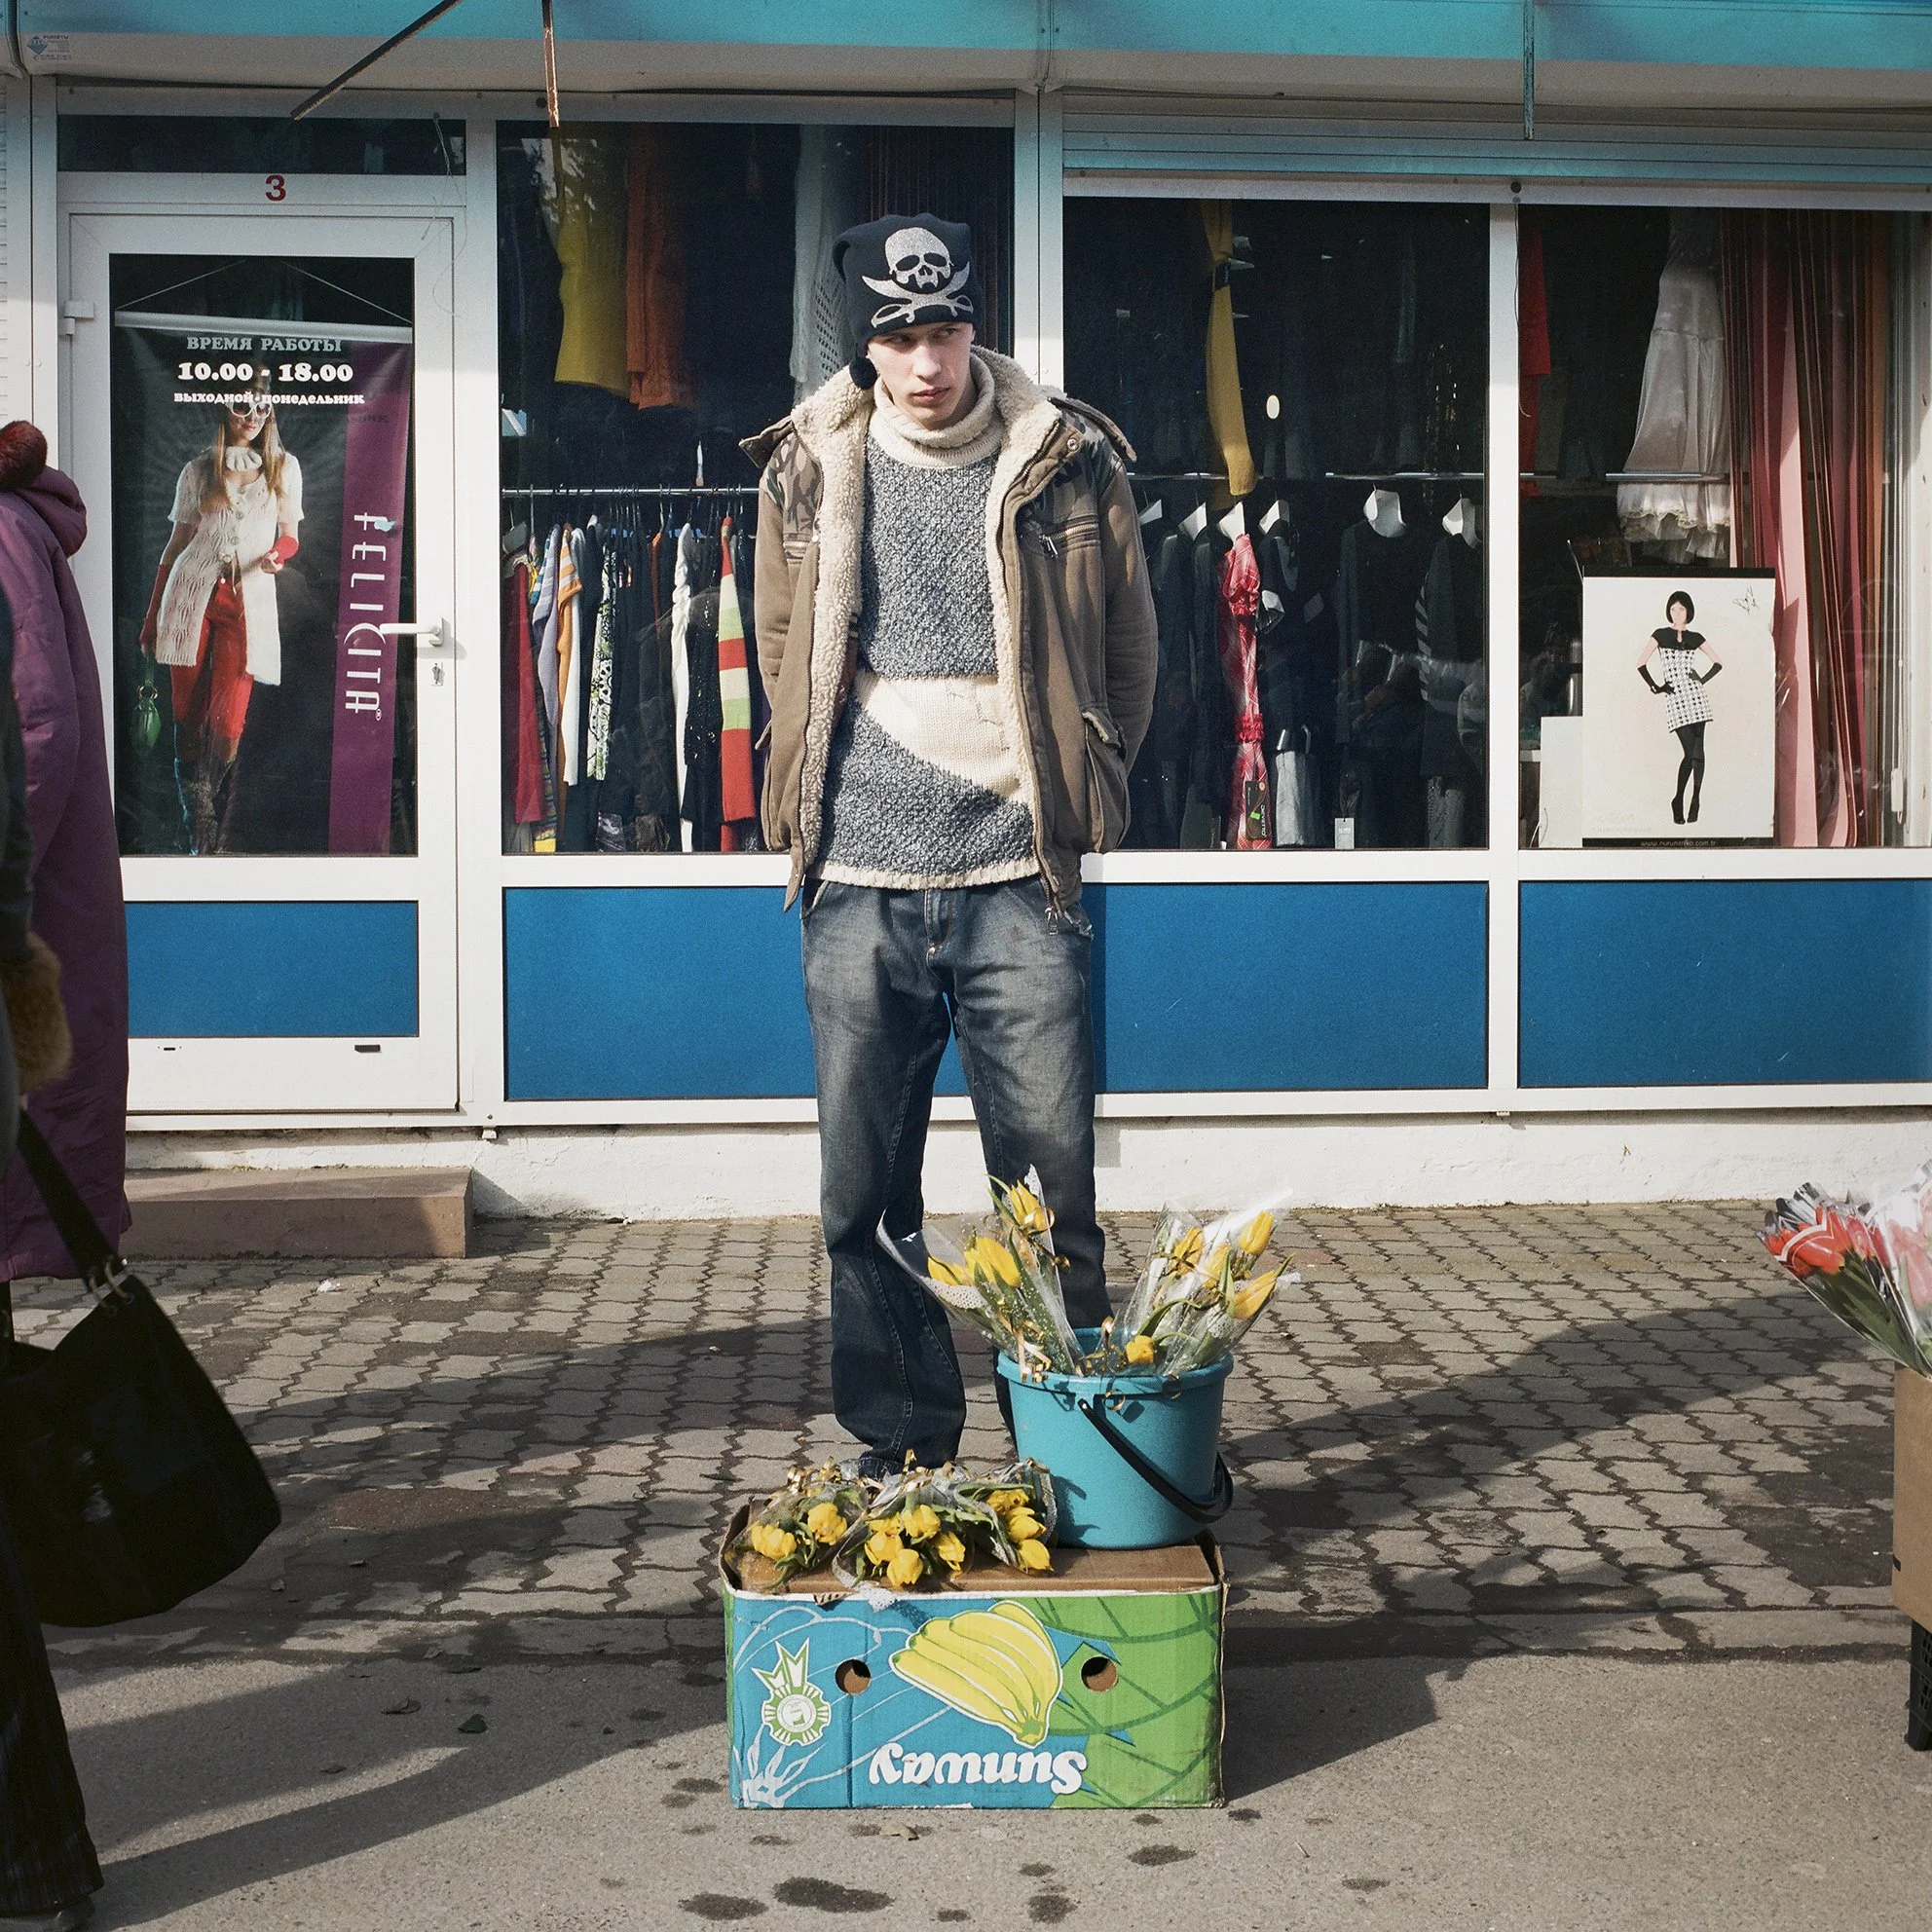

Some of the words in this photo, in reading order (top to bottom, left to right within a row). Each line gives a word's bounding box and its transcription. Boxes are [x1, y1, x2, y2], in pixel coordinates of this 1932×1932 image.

[265, 174, 286, 202] 3
[186, 336, 251, 352] ВРЕМЯ
[261, 338, 341, 353] РАБОТЫ
[177, 361, 253, 382] 10.00
[278, 362, 353, 383] 18.00
[344, 512, 387, 714] FELICITA
[869, 1742, 1088, 1795] Sunway
